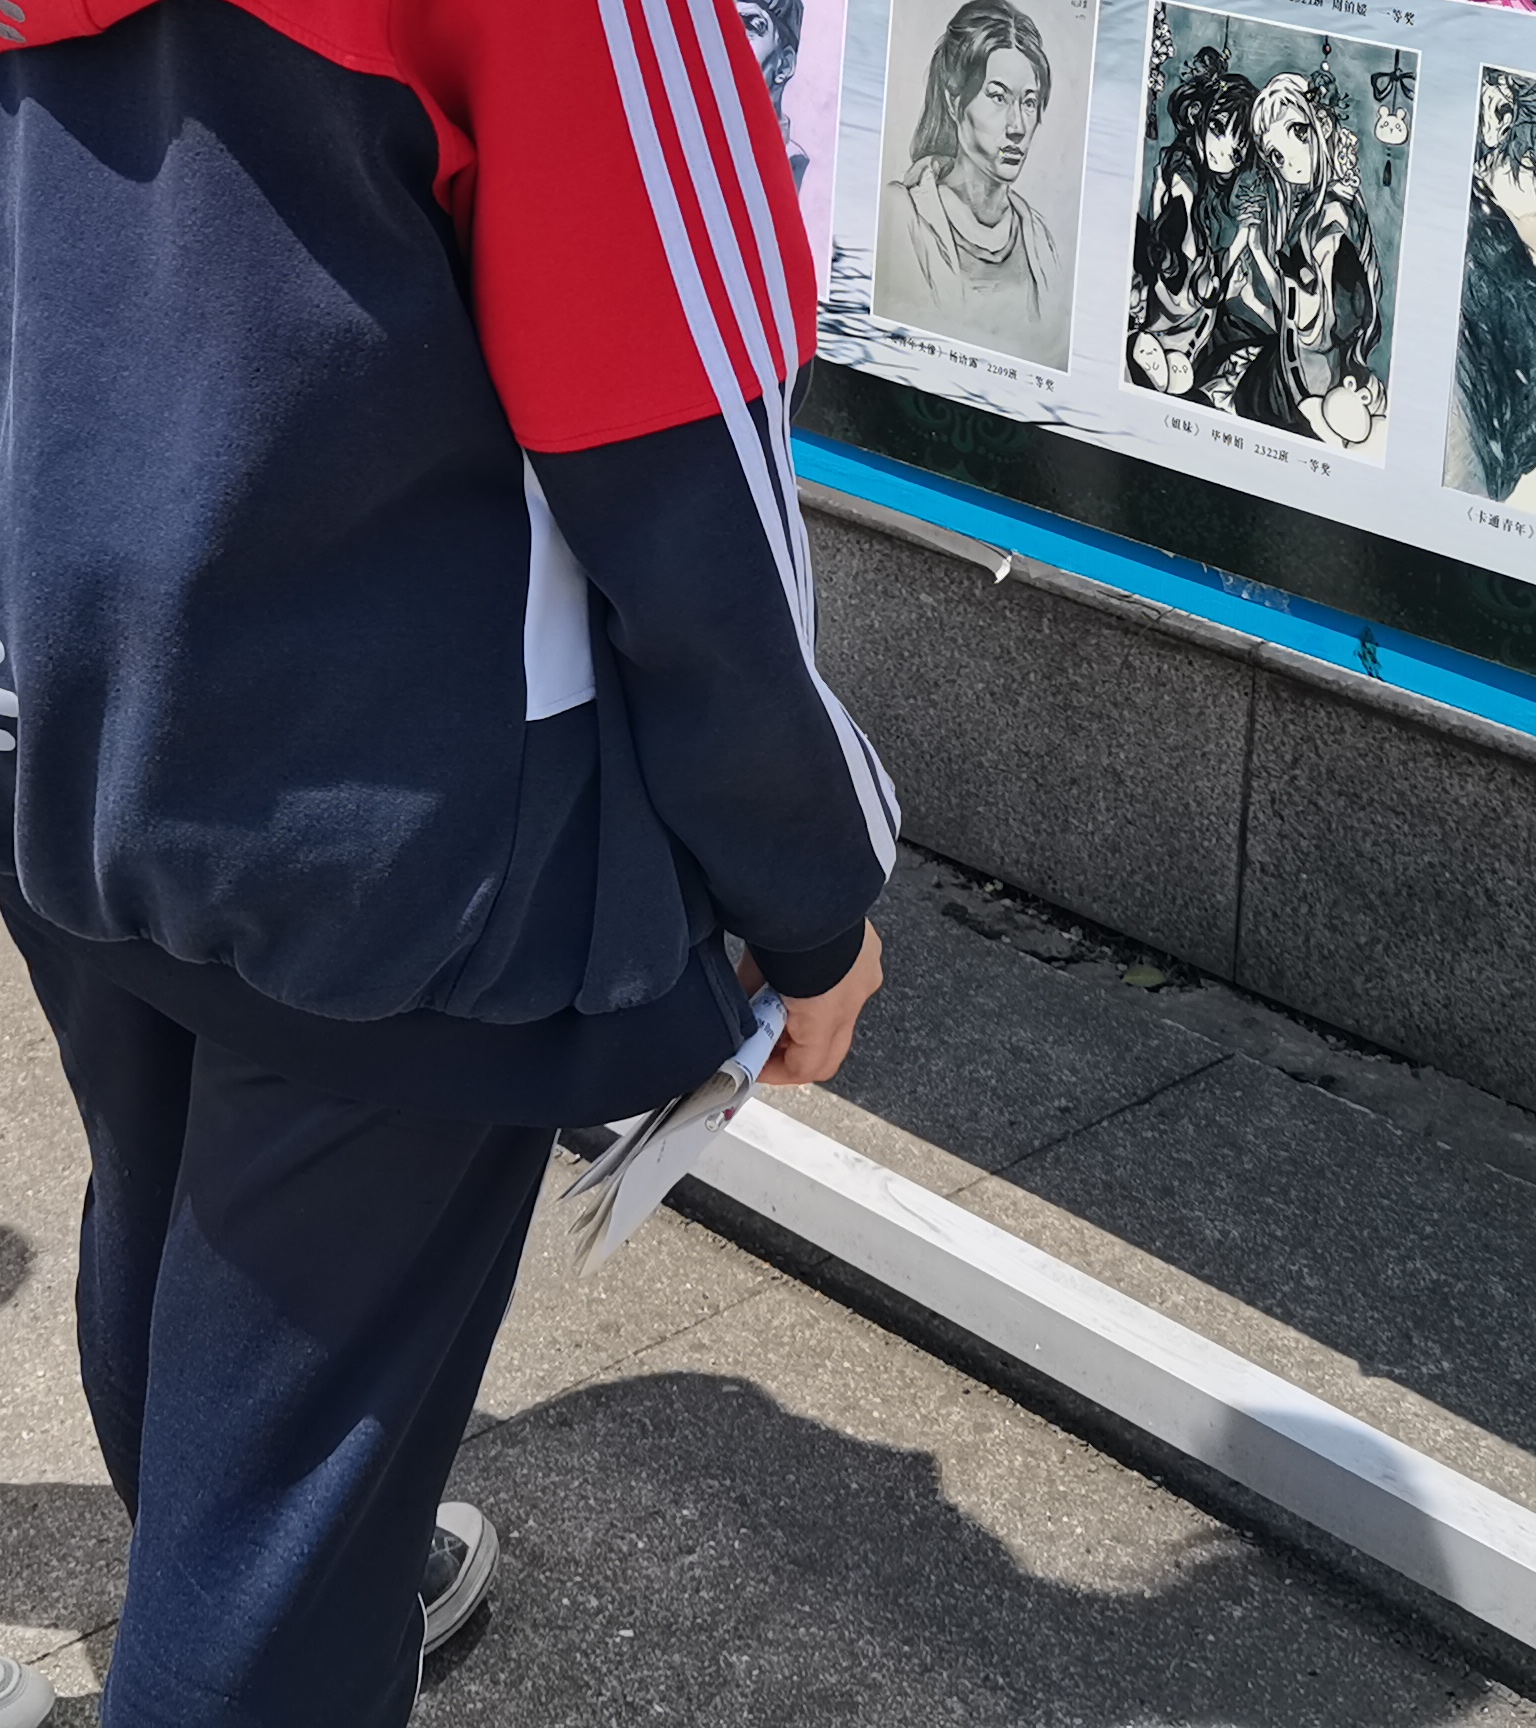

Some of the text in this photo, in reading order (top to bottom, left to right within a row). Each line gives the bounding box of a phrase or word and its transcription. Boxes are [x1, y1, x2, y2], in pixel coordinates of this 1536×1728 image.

[1384, 7, 1416, 27] 一等奖
[987, 362, 1018, 381] 2209班
[1025, 373, 1055, 393] 二等奖
[1254, 443, 1289, 464] 2322班
[1296, 458, 1332, 477] 一等奖
[1466, 506, 1535, 540] 《卡通青年》
